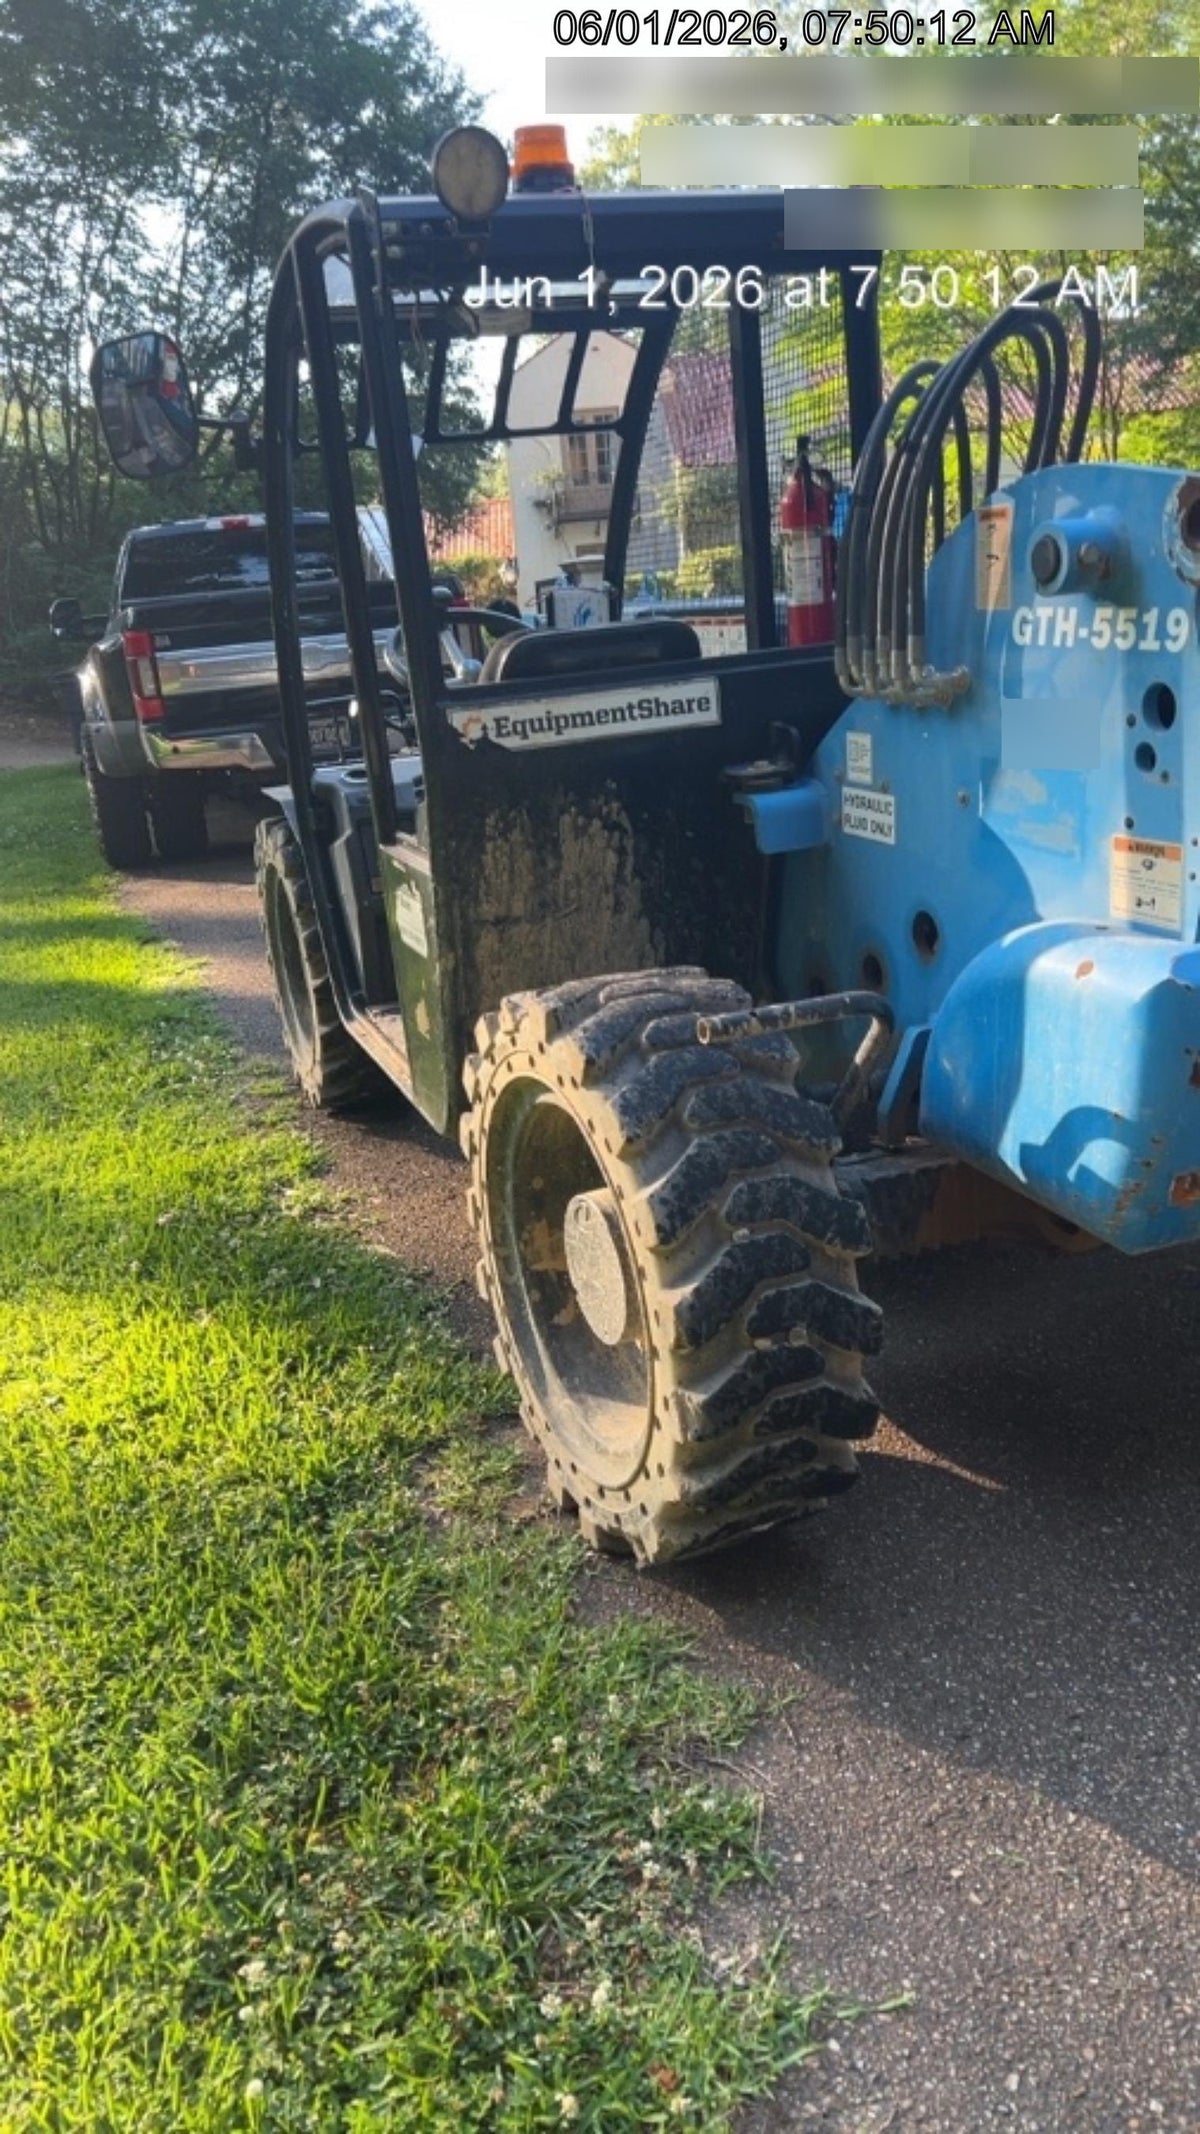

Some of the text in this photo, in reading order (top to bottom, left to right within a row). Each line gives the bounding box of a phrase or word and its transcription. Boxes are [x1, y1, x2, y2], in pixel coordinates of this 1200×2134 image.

[1012, 606, 1190, 653] GTH-5519
[492, 695, 711, 742] EquipmentShare
[843, 792, 894, 817] HYDRAULIC
[869, 819, 894, 838] ONLY
